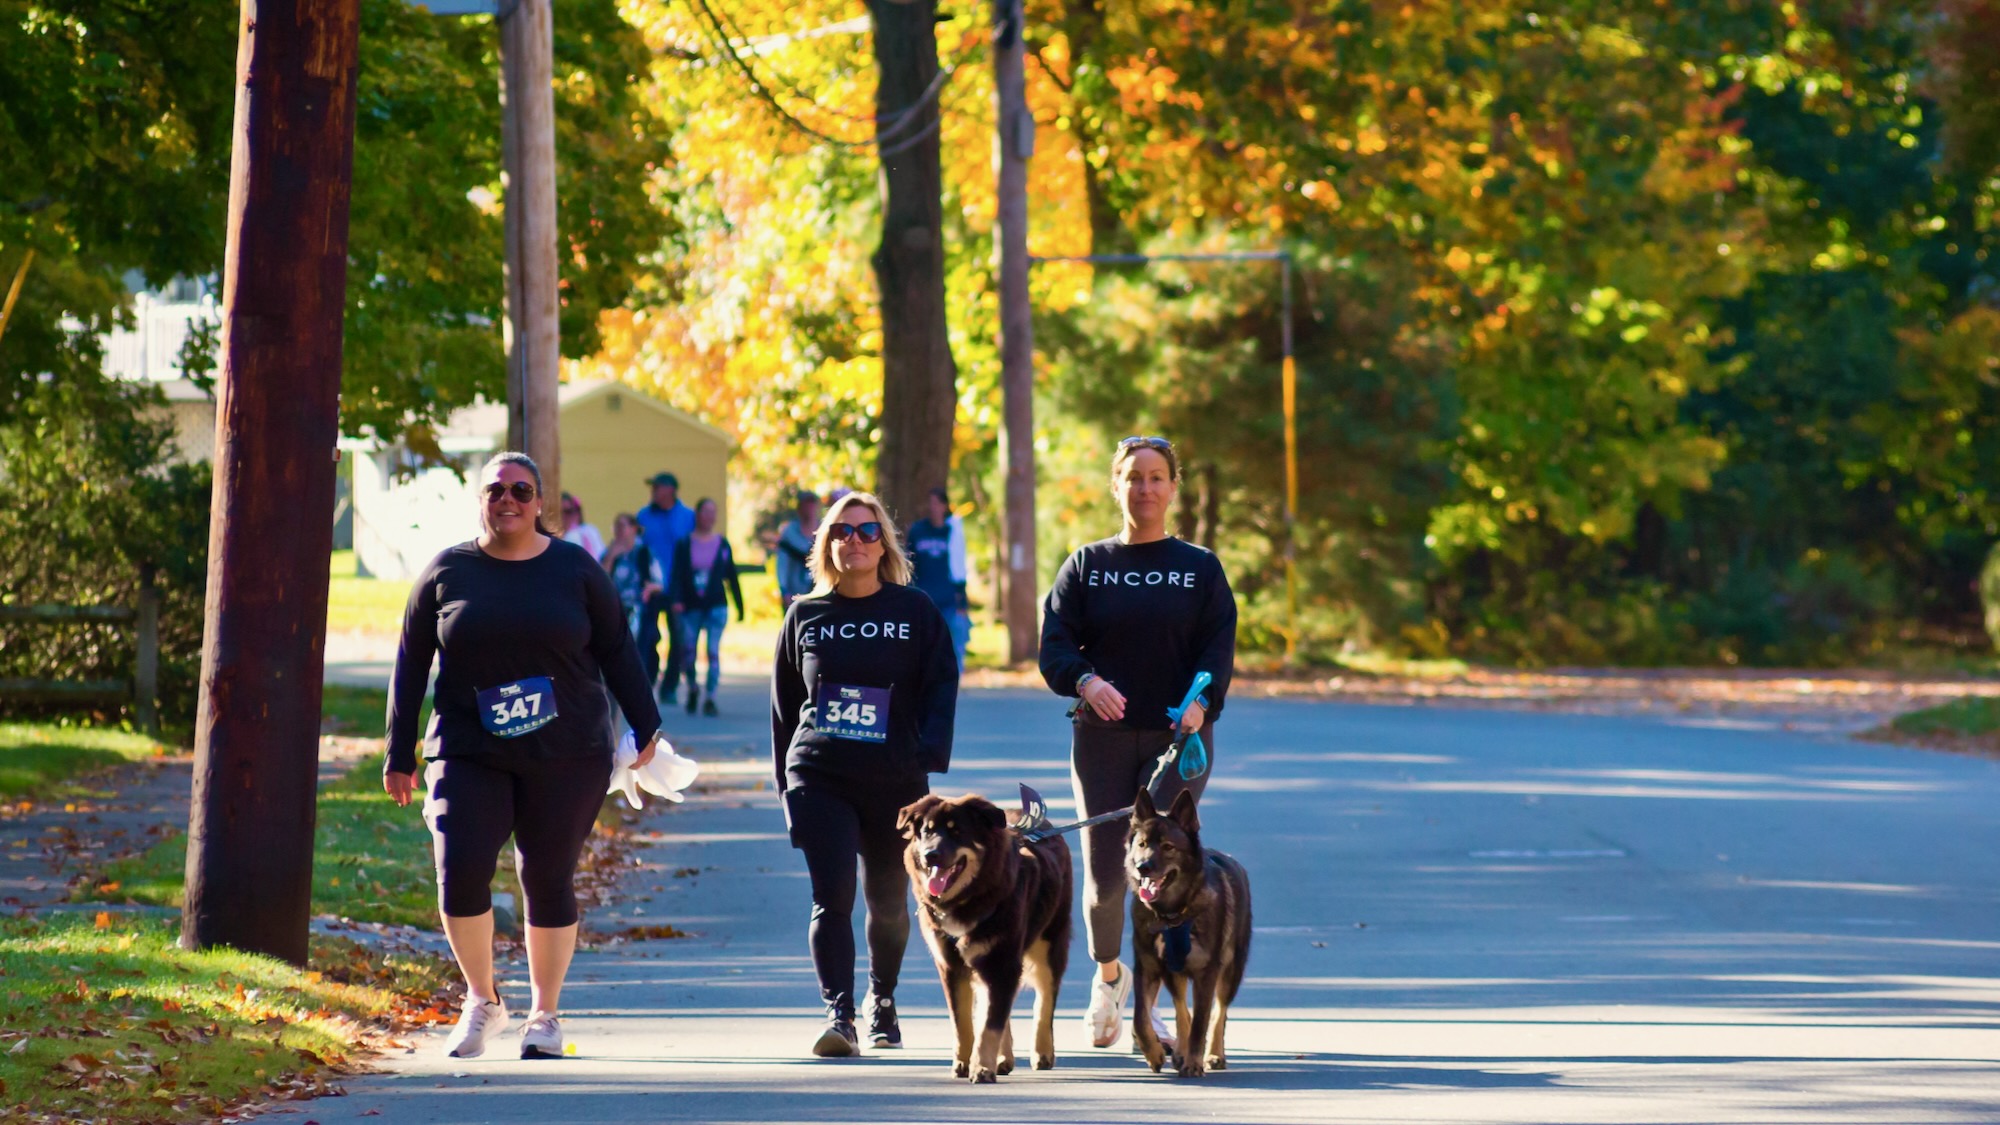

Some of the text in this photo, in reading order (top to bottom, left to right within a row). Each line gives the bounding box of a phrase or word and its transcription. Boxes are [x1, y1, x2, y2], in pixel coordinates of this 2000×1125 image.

[1089, 570, 1195, 587] ENCORE
[804, 622, 910, 643] ENCORE
[491, 693, 541, 724] 347
[826, 701, 876, 726] 345
